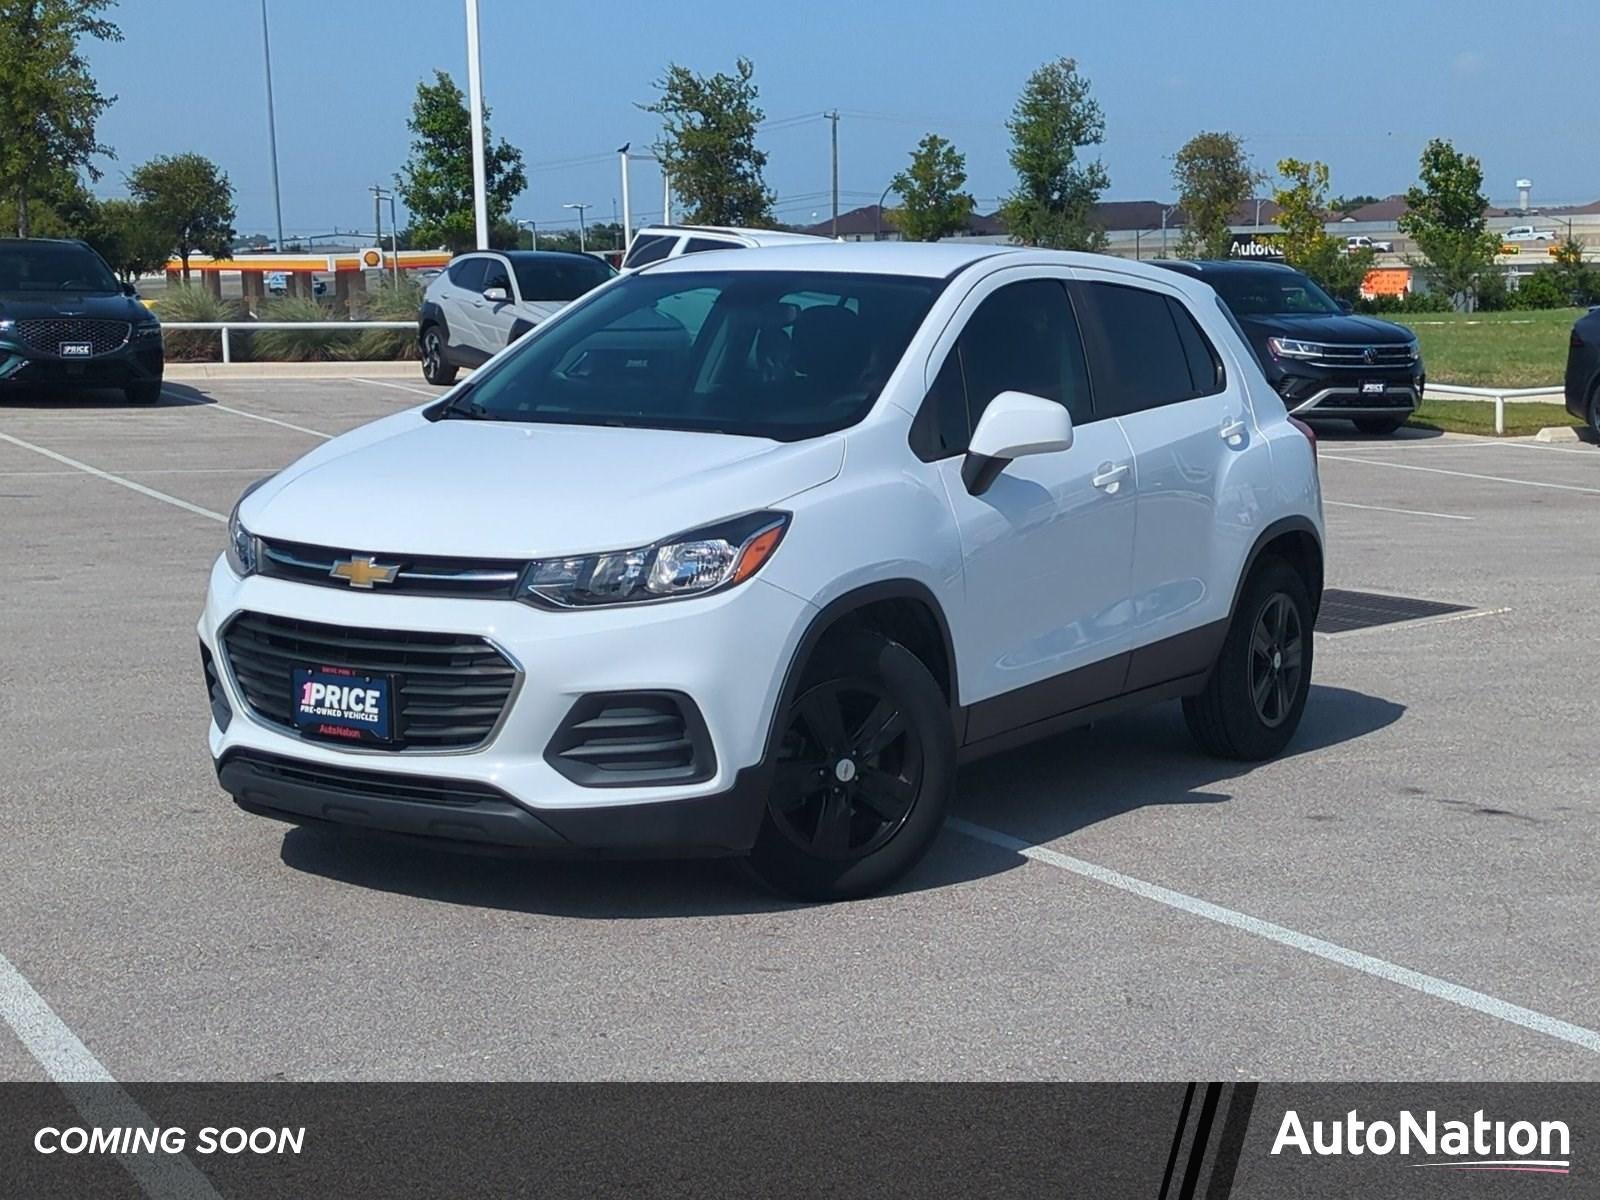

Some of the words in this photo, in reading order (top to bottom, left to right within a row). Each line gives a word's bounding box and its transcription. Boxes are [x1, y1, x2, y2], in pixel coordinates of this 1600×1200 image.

[1229, 241, 1285, 256] AutoNa
[301, 681, 380, 714] 1PRICE
[300, 705, 342, 718] PRE-OWNED
[344, 711, 379, 722] VEHICLES
[319, 724, 361, 738] AutoNation
